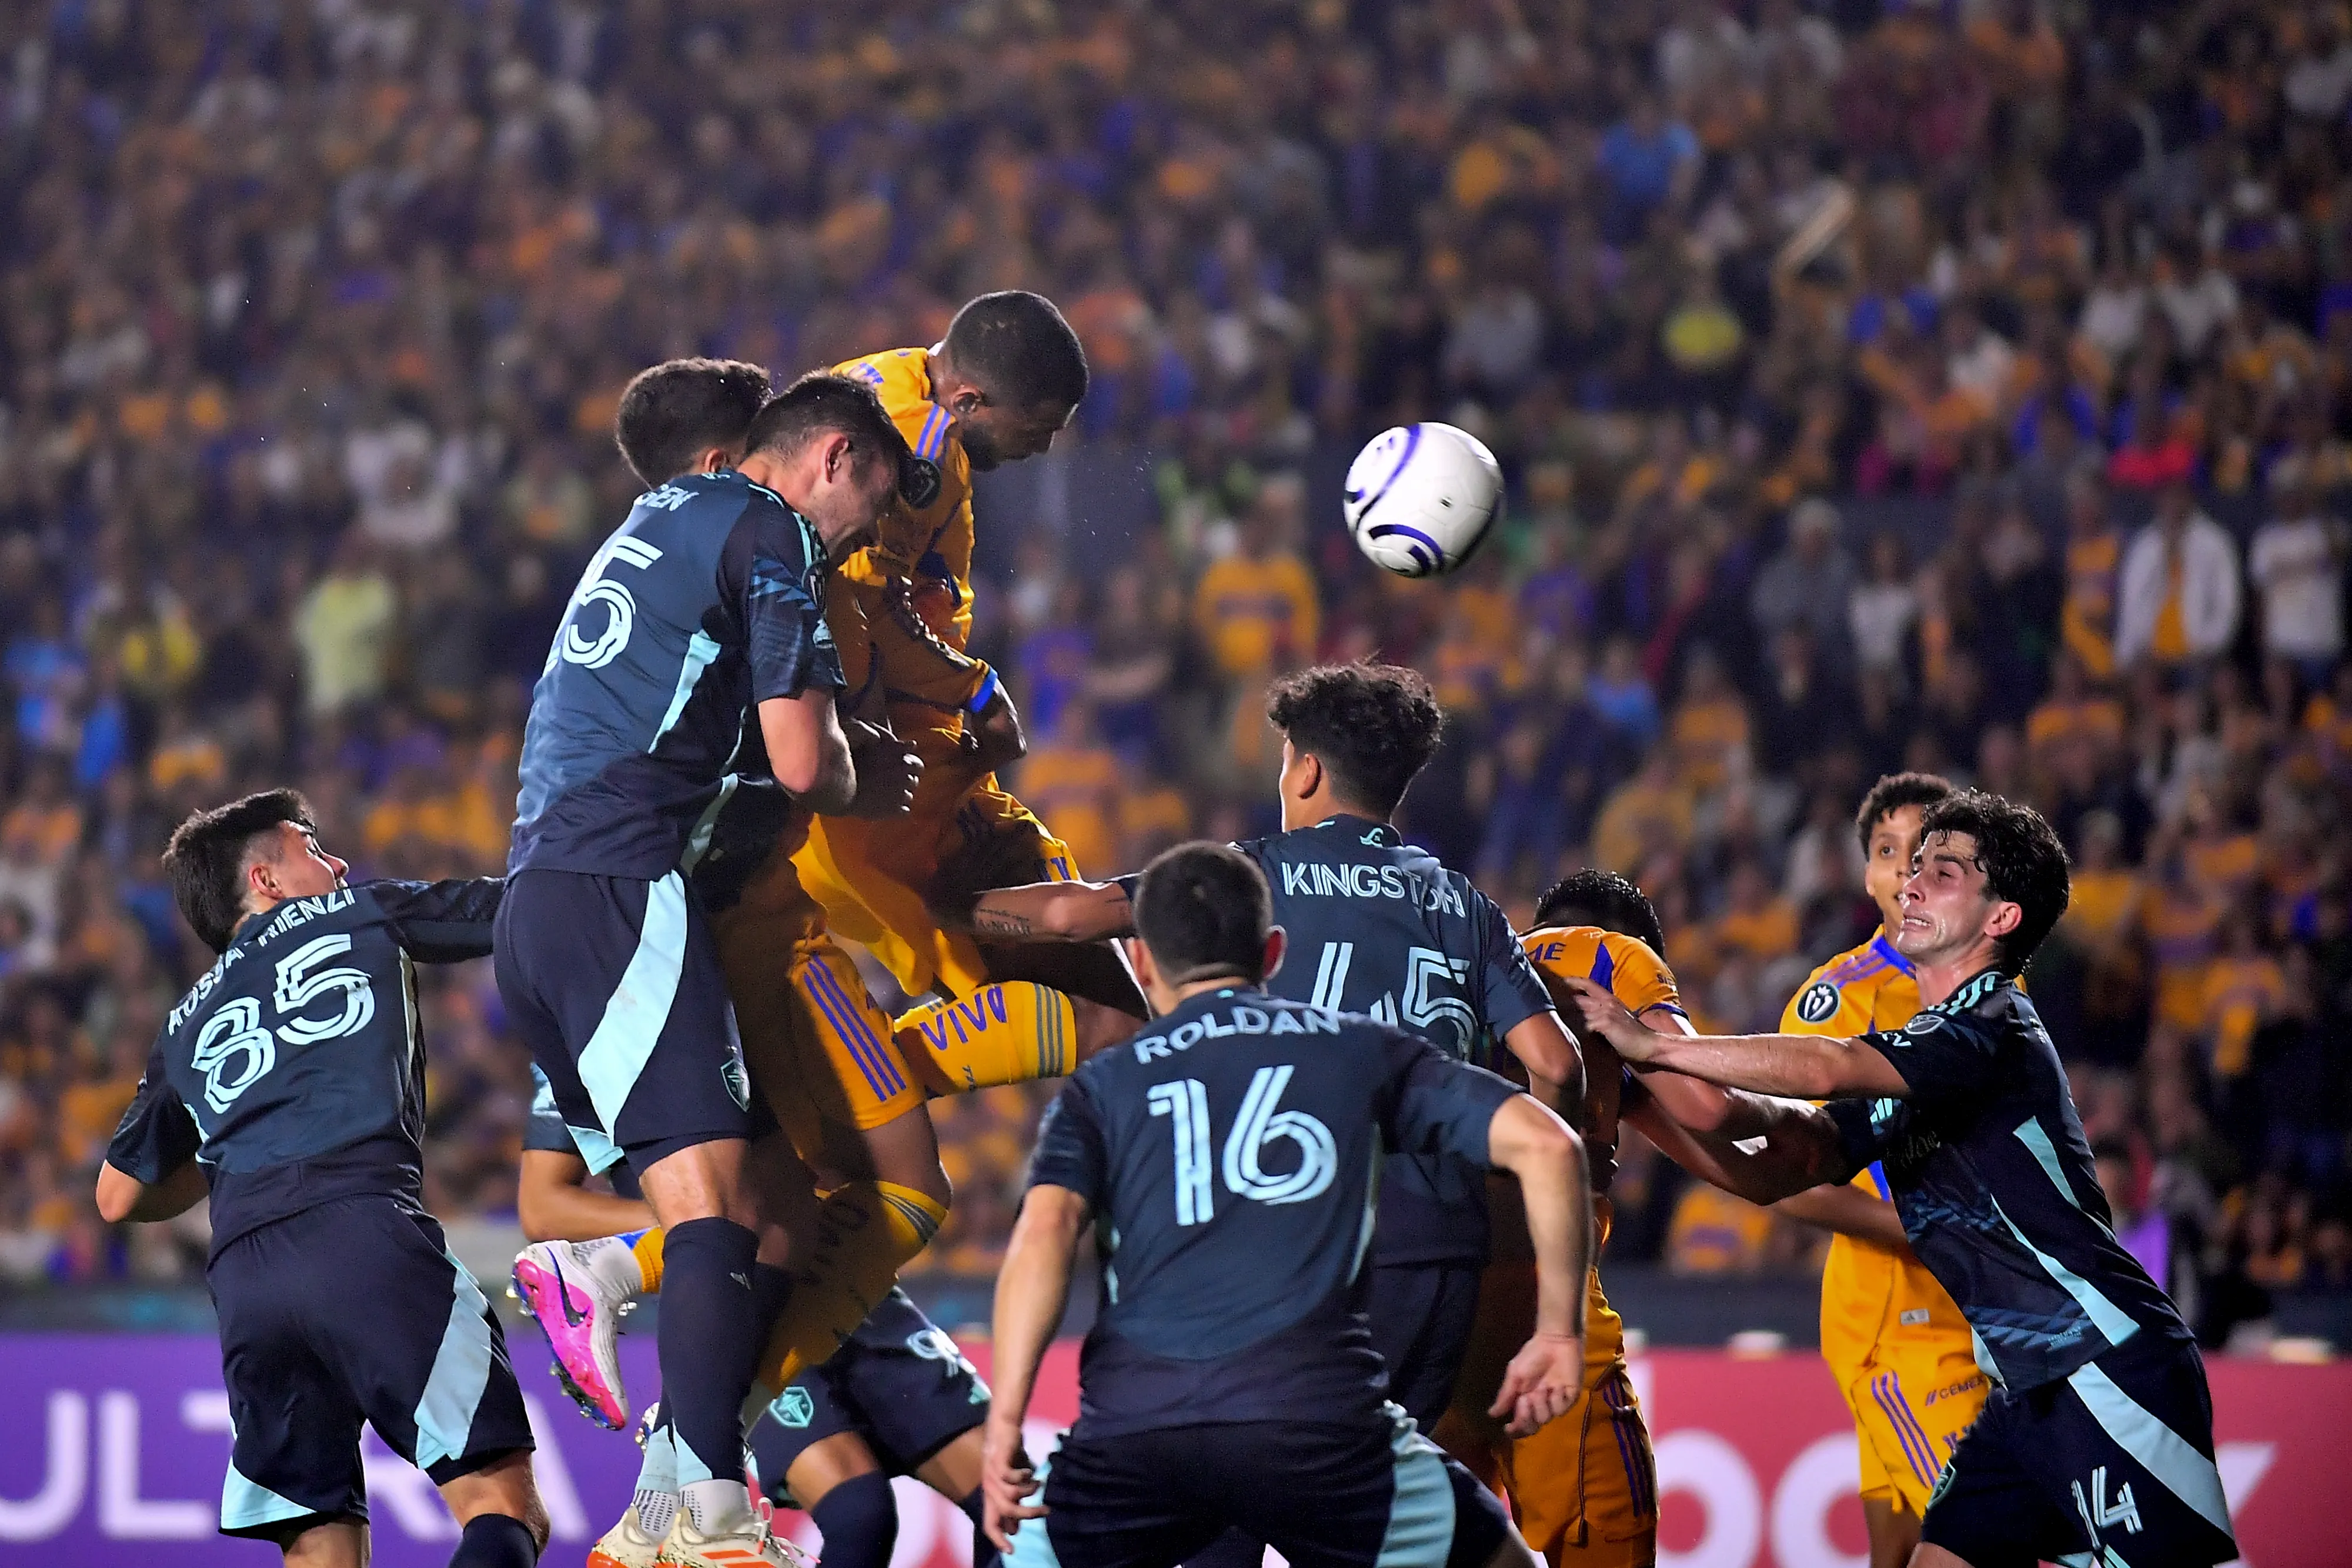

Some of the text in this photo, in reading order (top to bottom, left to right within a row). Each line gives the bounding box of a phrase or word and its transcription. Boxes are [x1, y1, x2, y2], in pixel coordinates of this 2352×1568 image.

[542, 536, 664, 677] 5
[1281, 862, 1466, 918] KINGSTON
[191, 934, 375, 1114] 85
[1134, 1007, 1342, 1064] ROLDAN
[1148, 1065, 1338, 1226] 16
[2070, 1466, 2143, 1550] 14
